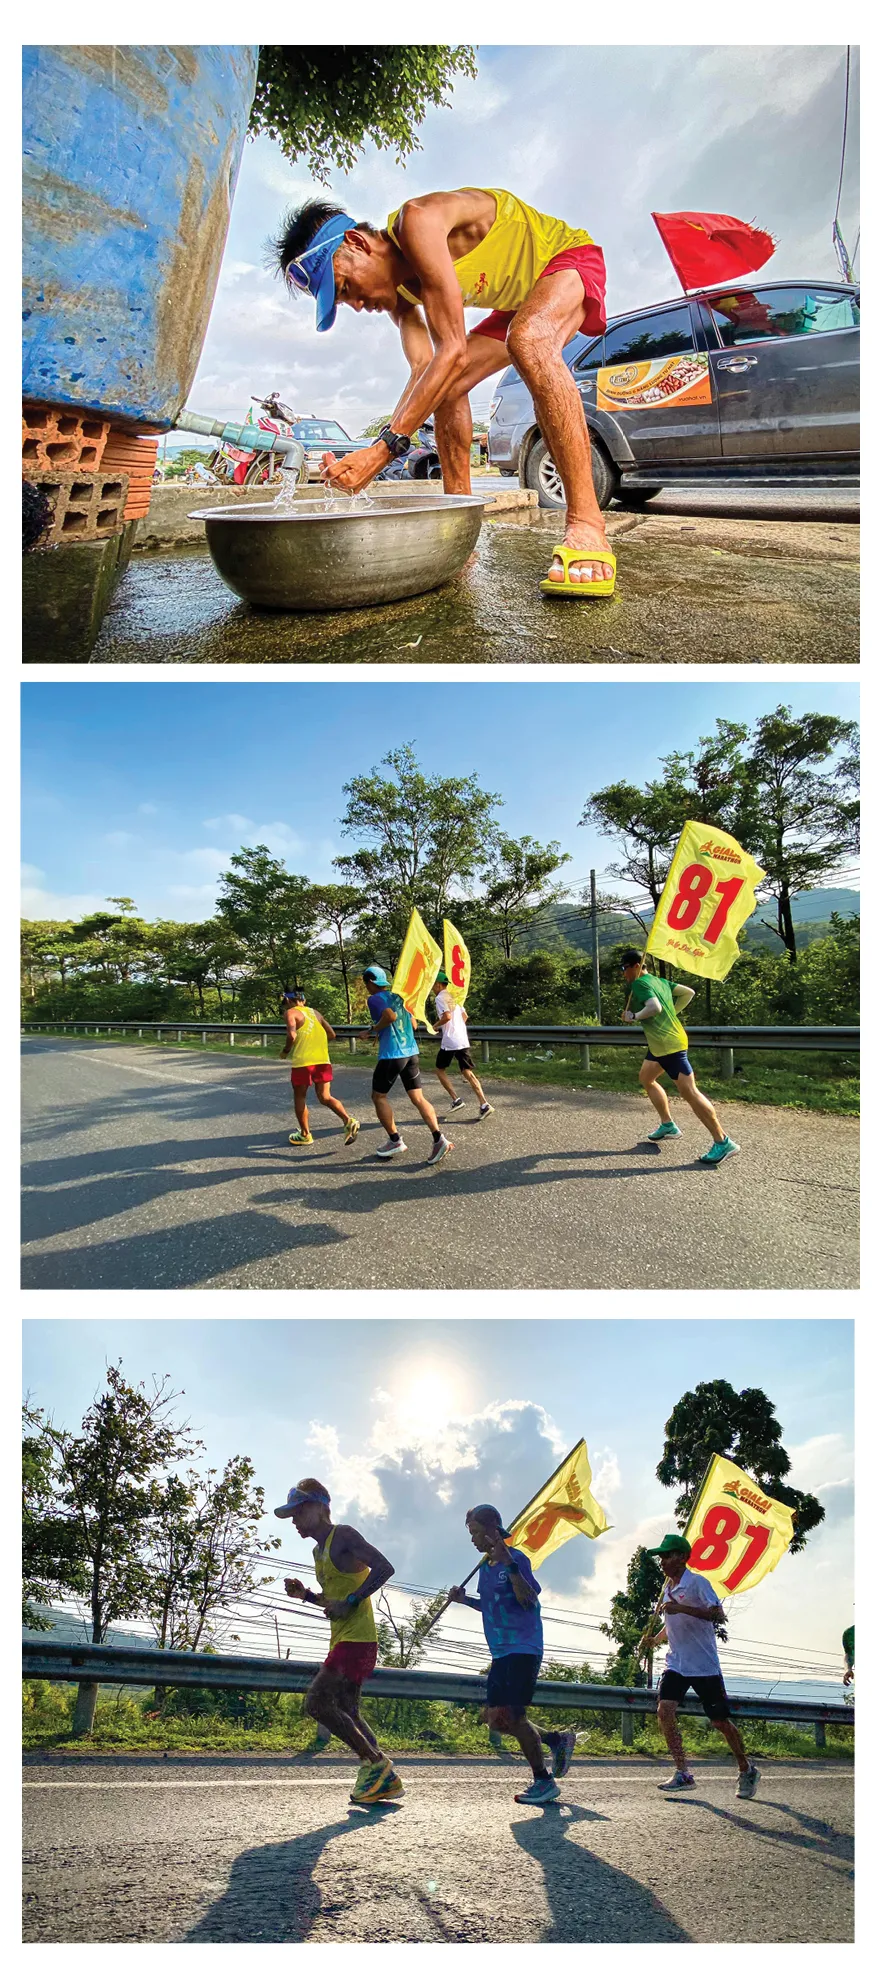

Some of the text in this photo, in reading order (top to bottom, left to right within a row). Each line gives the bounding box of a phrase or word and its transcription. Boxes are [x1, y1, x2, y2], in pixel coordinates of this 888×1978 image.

[713, 854, 741, 864] MARATHON
[667, 863, 745, 944] 81
[740, 1487, 773, 1510] GIALAI
[740, 1496, 767, 1515] MARATHON
[686, 1504, 772, 1592] 81
